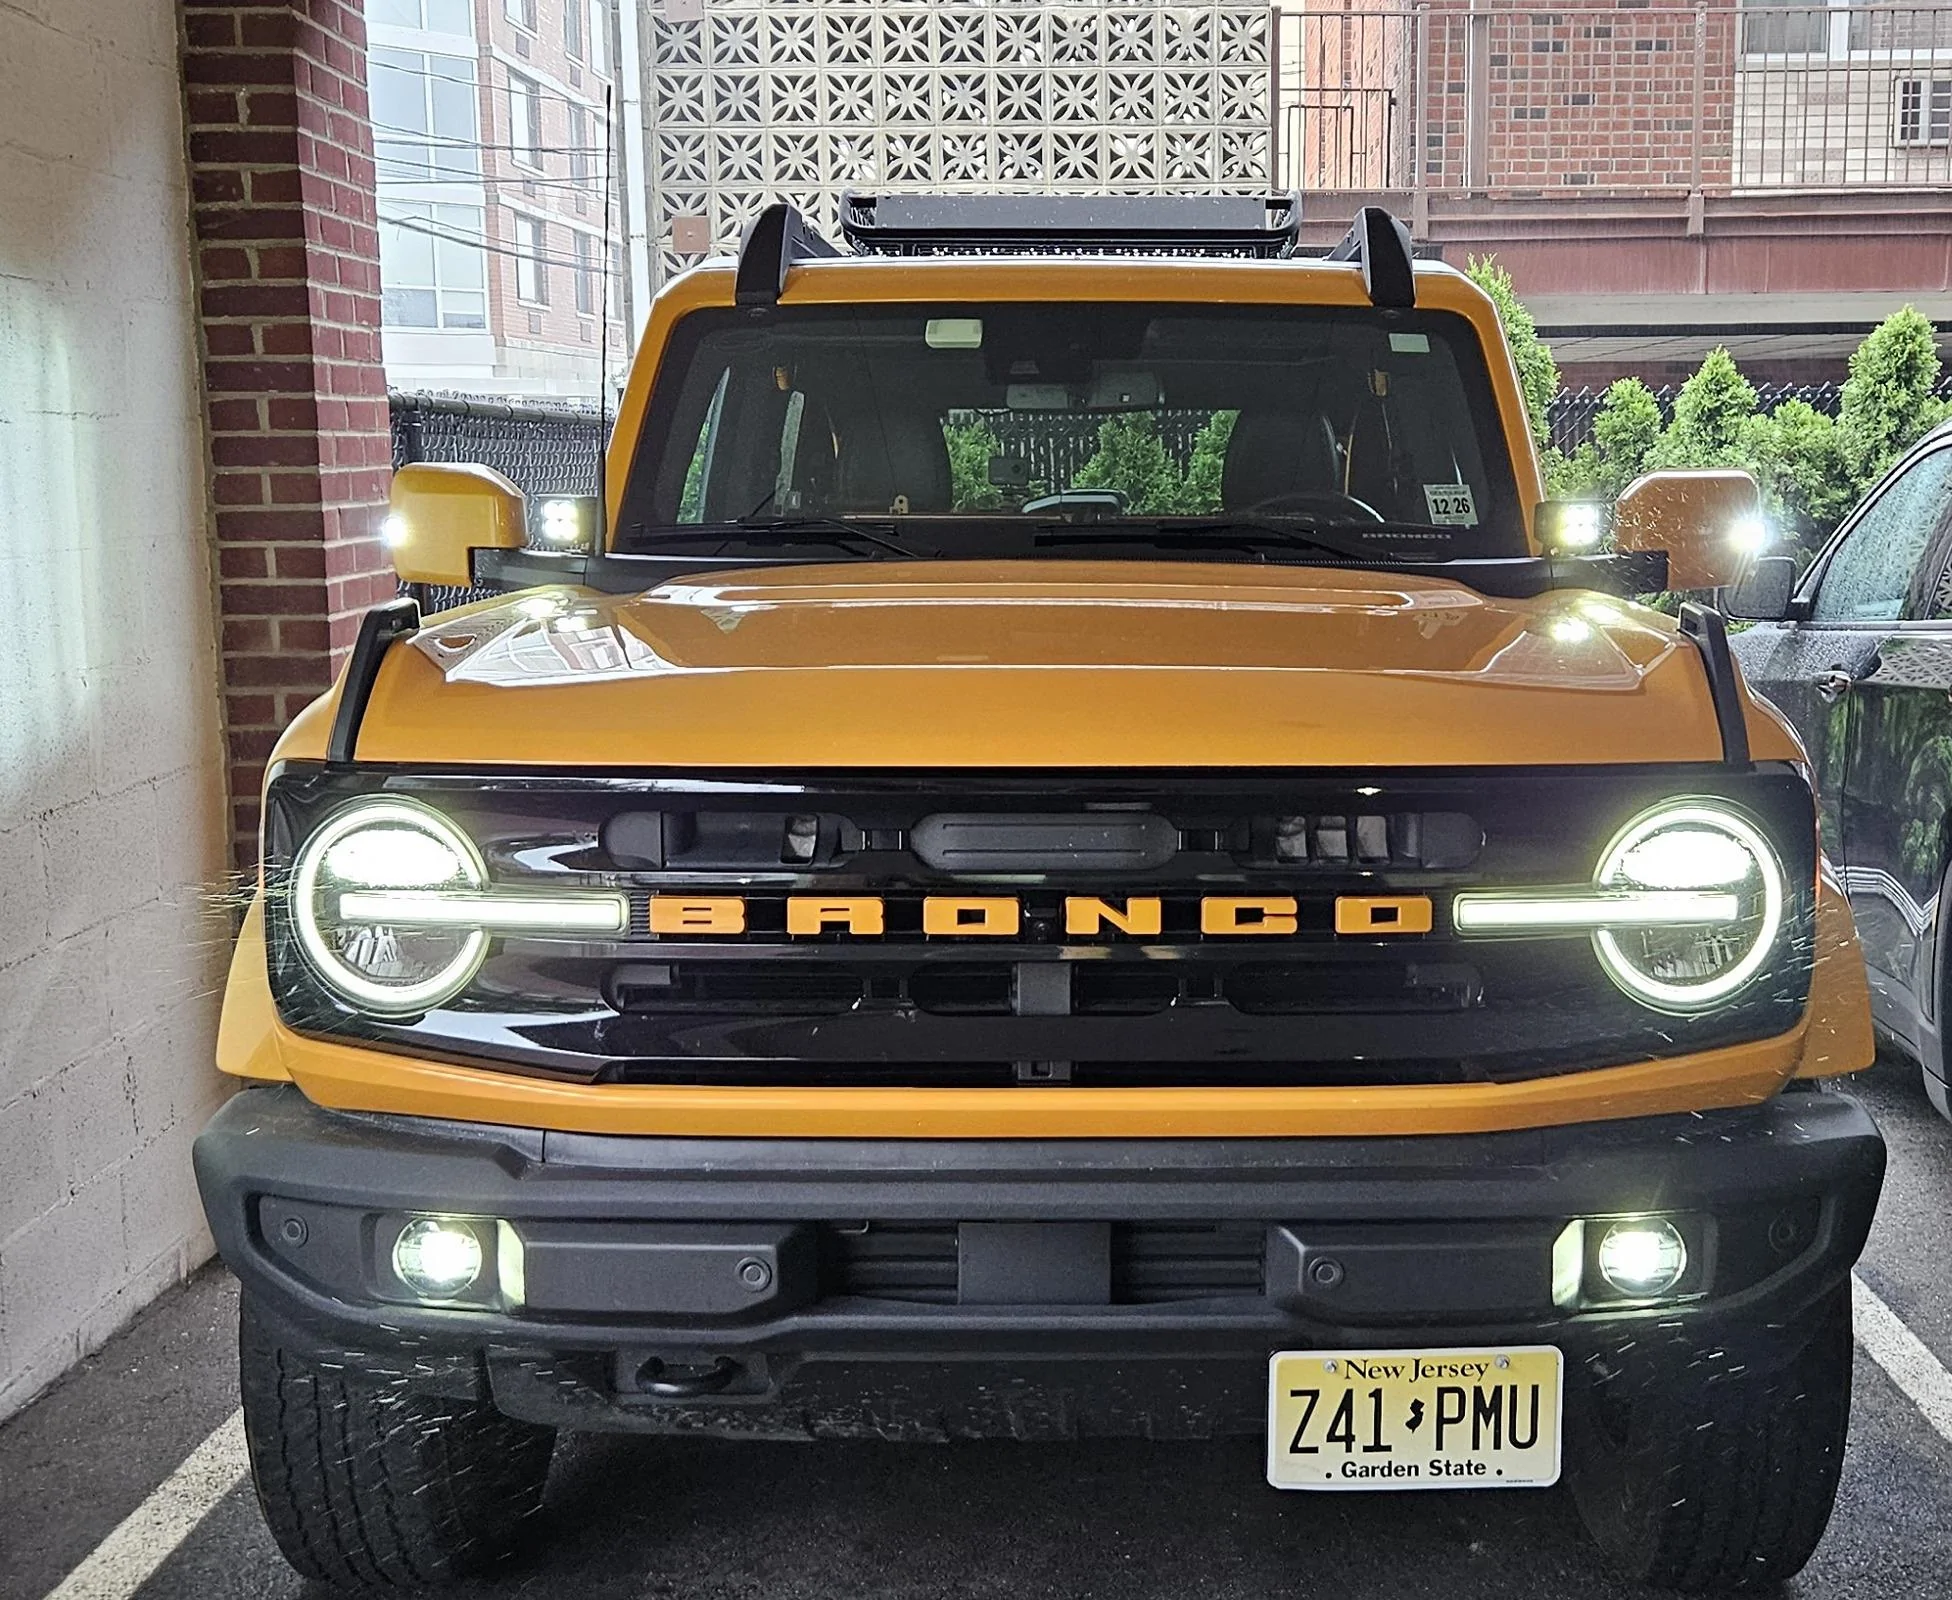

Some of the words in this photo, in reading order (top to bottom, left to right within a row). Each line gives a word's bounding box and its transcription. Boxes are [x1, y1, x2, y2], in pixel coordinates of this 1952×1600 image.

[1432, 498, 1451, 515] 12
[1453, 497, 1471, 514] 26
[649, 896, 1433, 935] BRONCO
[1344, 1359, 1406, 1380] New
[1409, 1357, 1490, 1383] Jersey
[1289, 1388, 1393, 1454] Z41
[1436, 1384, 1540, 1451] PMU
[1341, 1460, 1420, 1478] Garden
[1429, 1459, 1487, 1476] State
